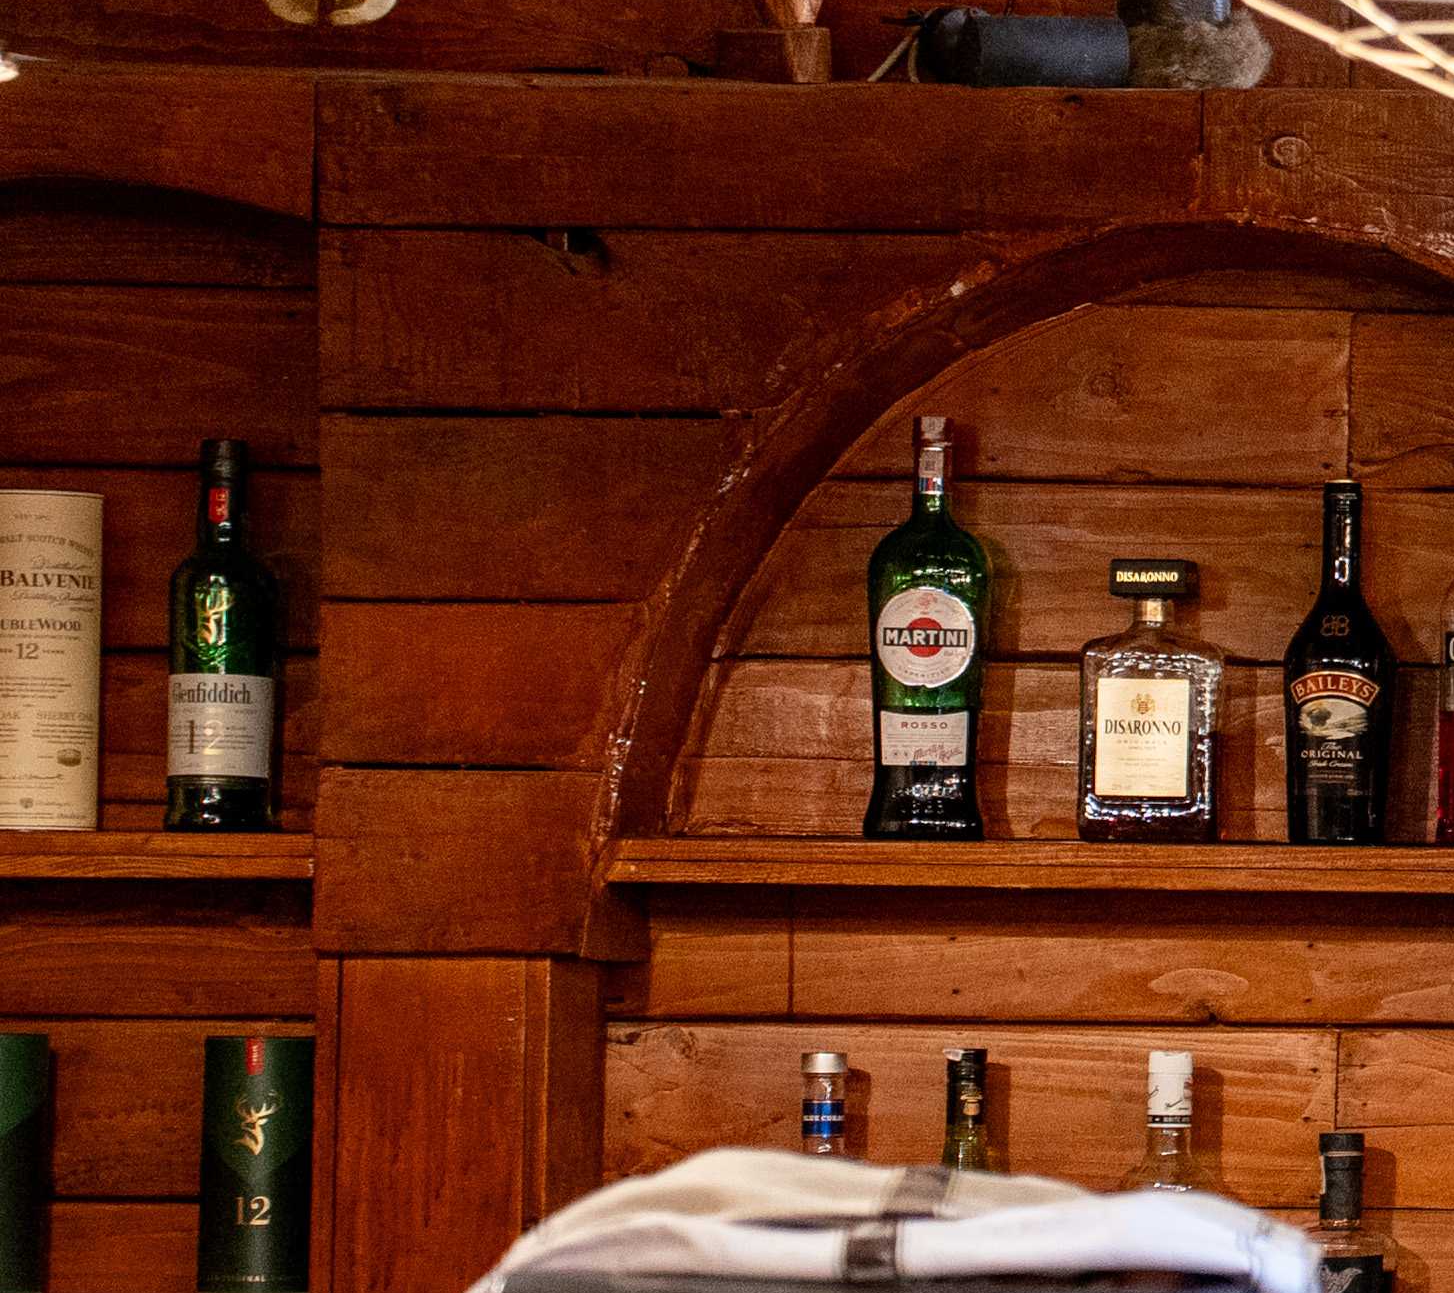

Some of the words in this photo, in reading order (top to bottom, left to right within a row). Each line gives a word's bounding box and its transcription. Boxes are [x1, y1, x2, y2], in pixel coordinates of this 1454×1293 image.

[1116, 571, 1178, 583] DISARONNO
[885, 629, 966, 646] MARTINI
[16, 643, 39, 660] 12
[172, 682, 252, 705] Glenfiddich
[1294, 675, 1375, 698] BAILEYS
[901, 720, 949, 730] ROSSO
[1104, 719, 1181, 737] DISARONNO
[1300, 749, 1364, 760] ORIGINAL
[235, 1195, 272, 1227] 12
